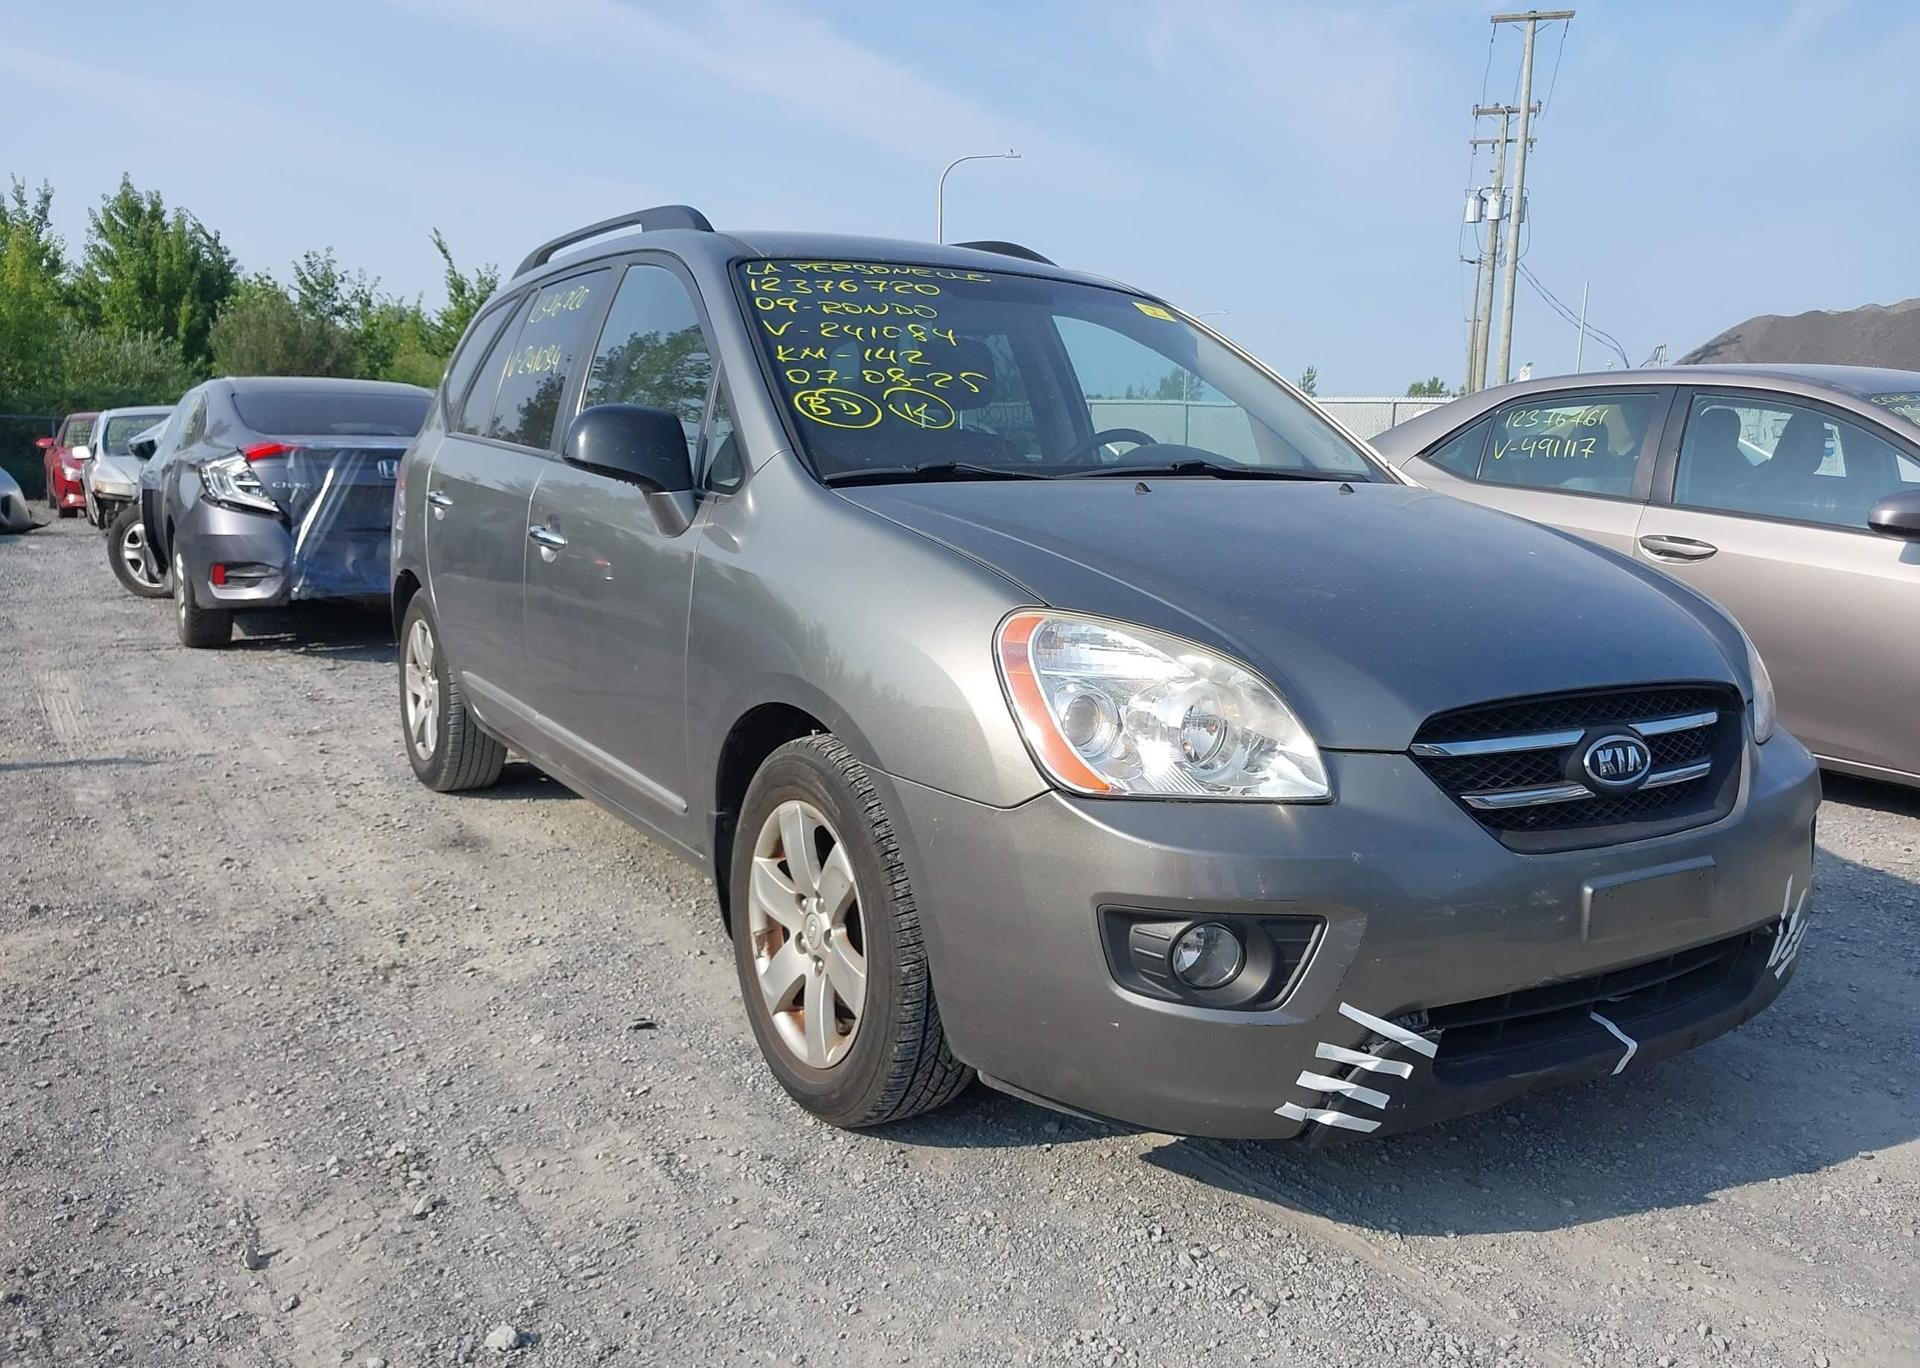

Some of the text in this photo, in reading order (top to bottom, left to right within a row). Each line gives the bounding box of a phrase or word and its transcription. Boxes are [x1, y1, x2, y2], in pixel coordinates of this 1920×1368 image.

[746, 262, 783, 275] LA
[750, 277, 940, 296] 12376720
[1505, 409, 1608, 428] 12376761
[1494, 437, 1596, 459] V-491117
[1596, 746, 1643, 776] KIA
